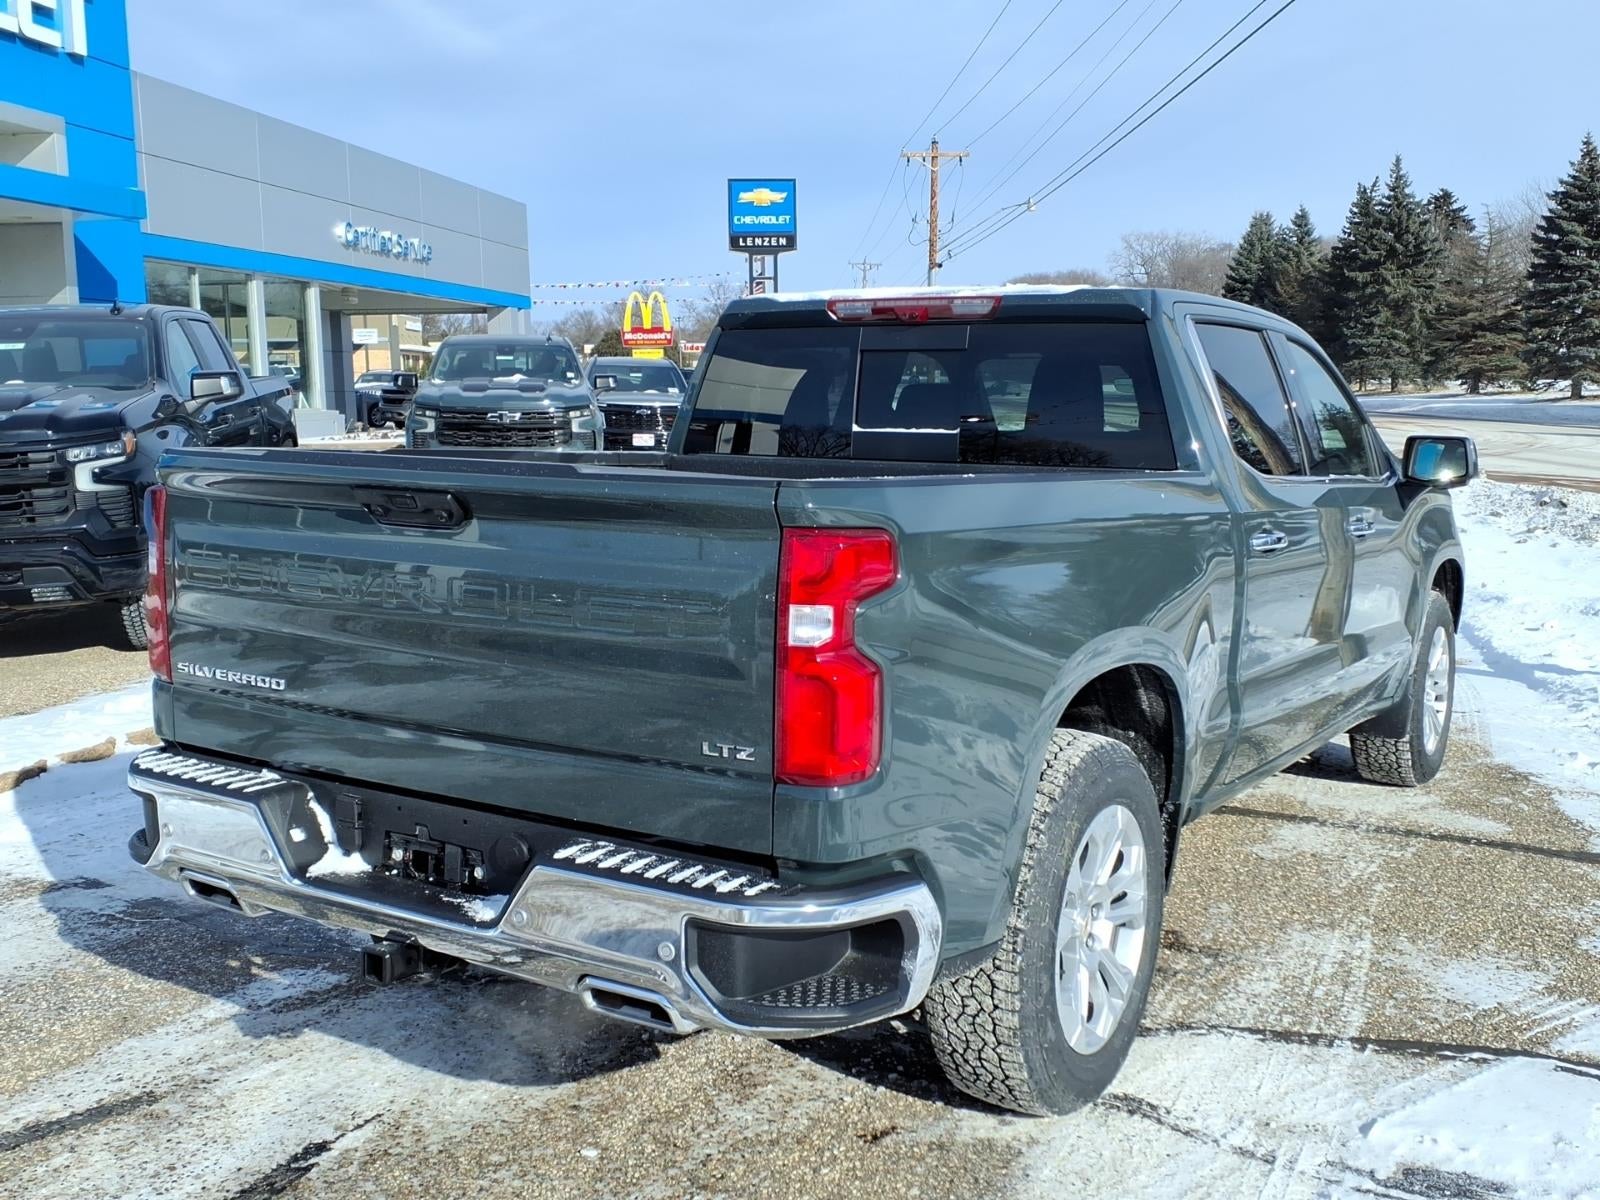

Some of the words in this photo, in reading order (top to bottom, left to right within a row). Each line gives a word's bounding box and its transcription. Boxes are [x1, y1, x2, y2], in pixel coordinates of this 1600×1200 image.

[733, 215, 791, 225] CHEVROLET
[343, 221, 393, 252] Certified
[394, 233, 433, 262] Service
[739, 237, 787, 246] LENZEN
[624, 332, 671, 340] McDonald's
[185, 548, 731, 639] CHEVROLET
[177, 661, 287, 691] SILVERADO
[702, 741, 755, 761] LTZ
